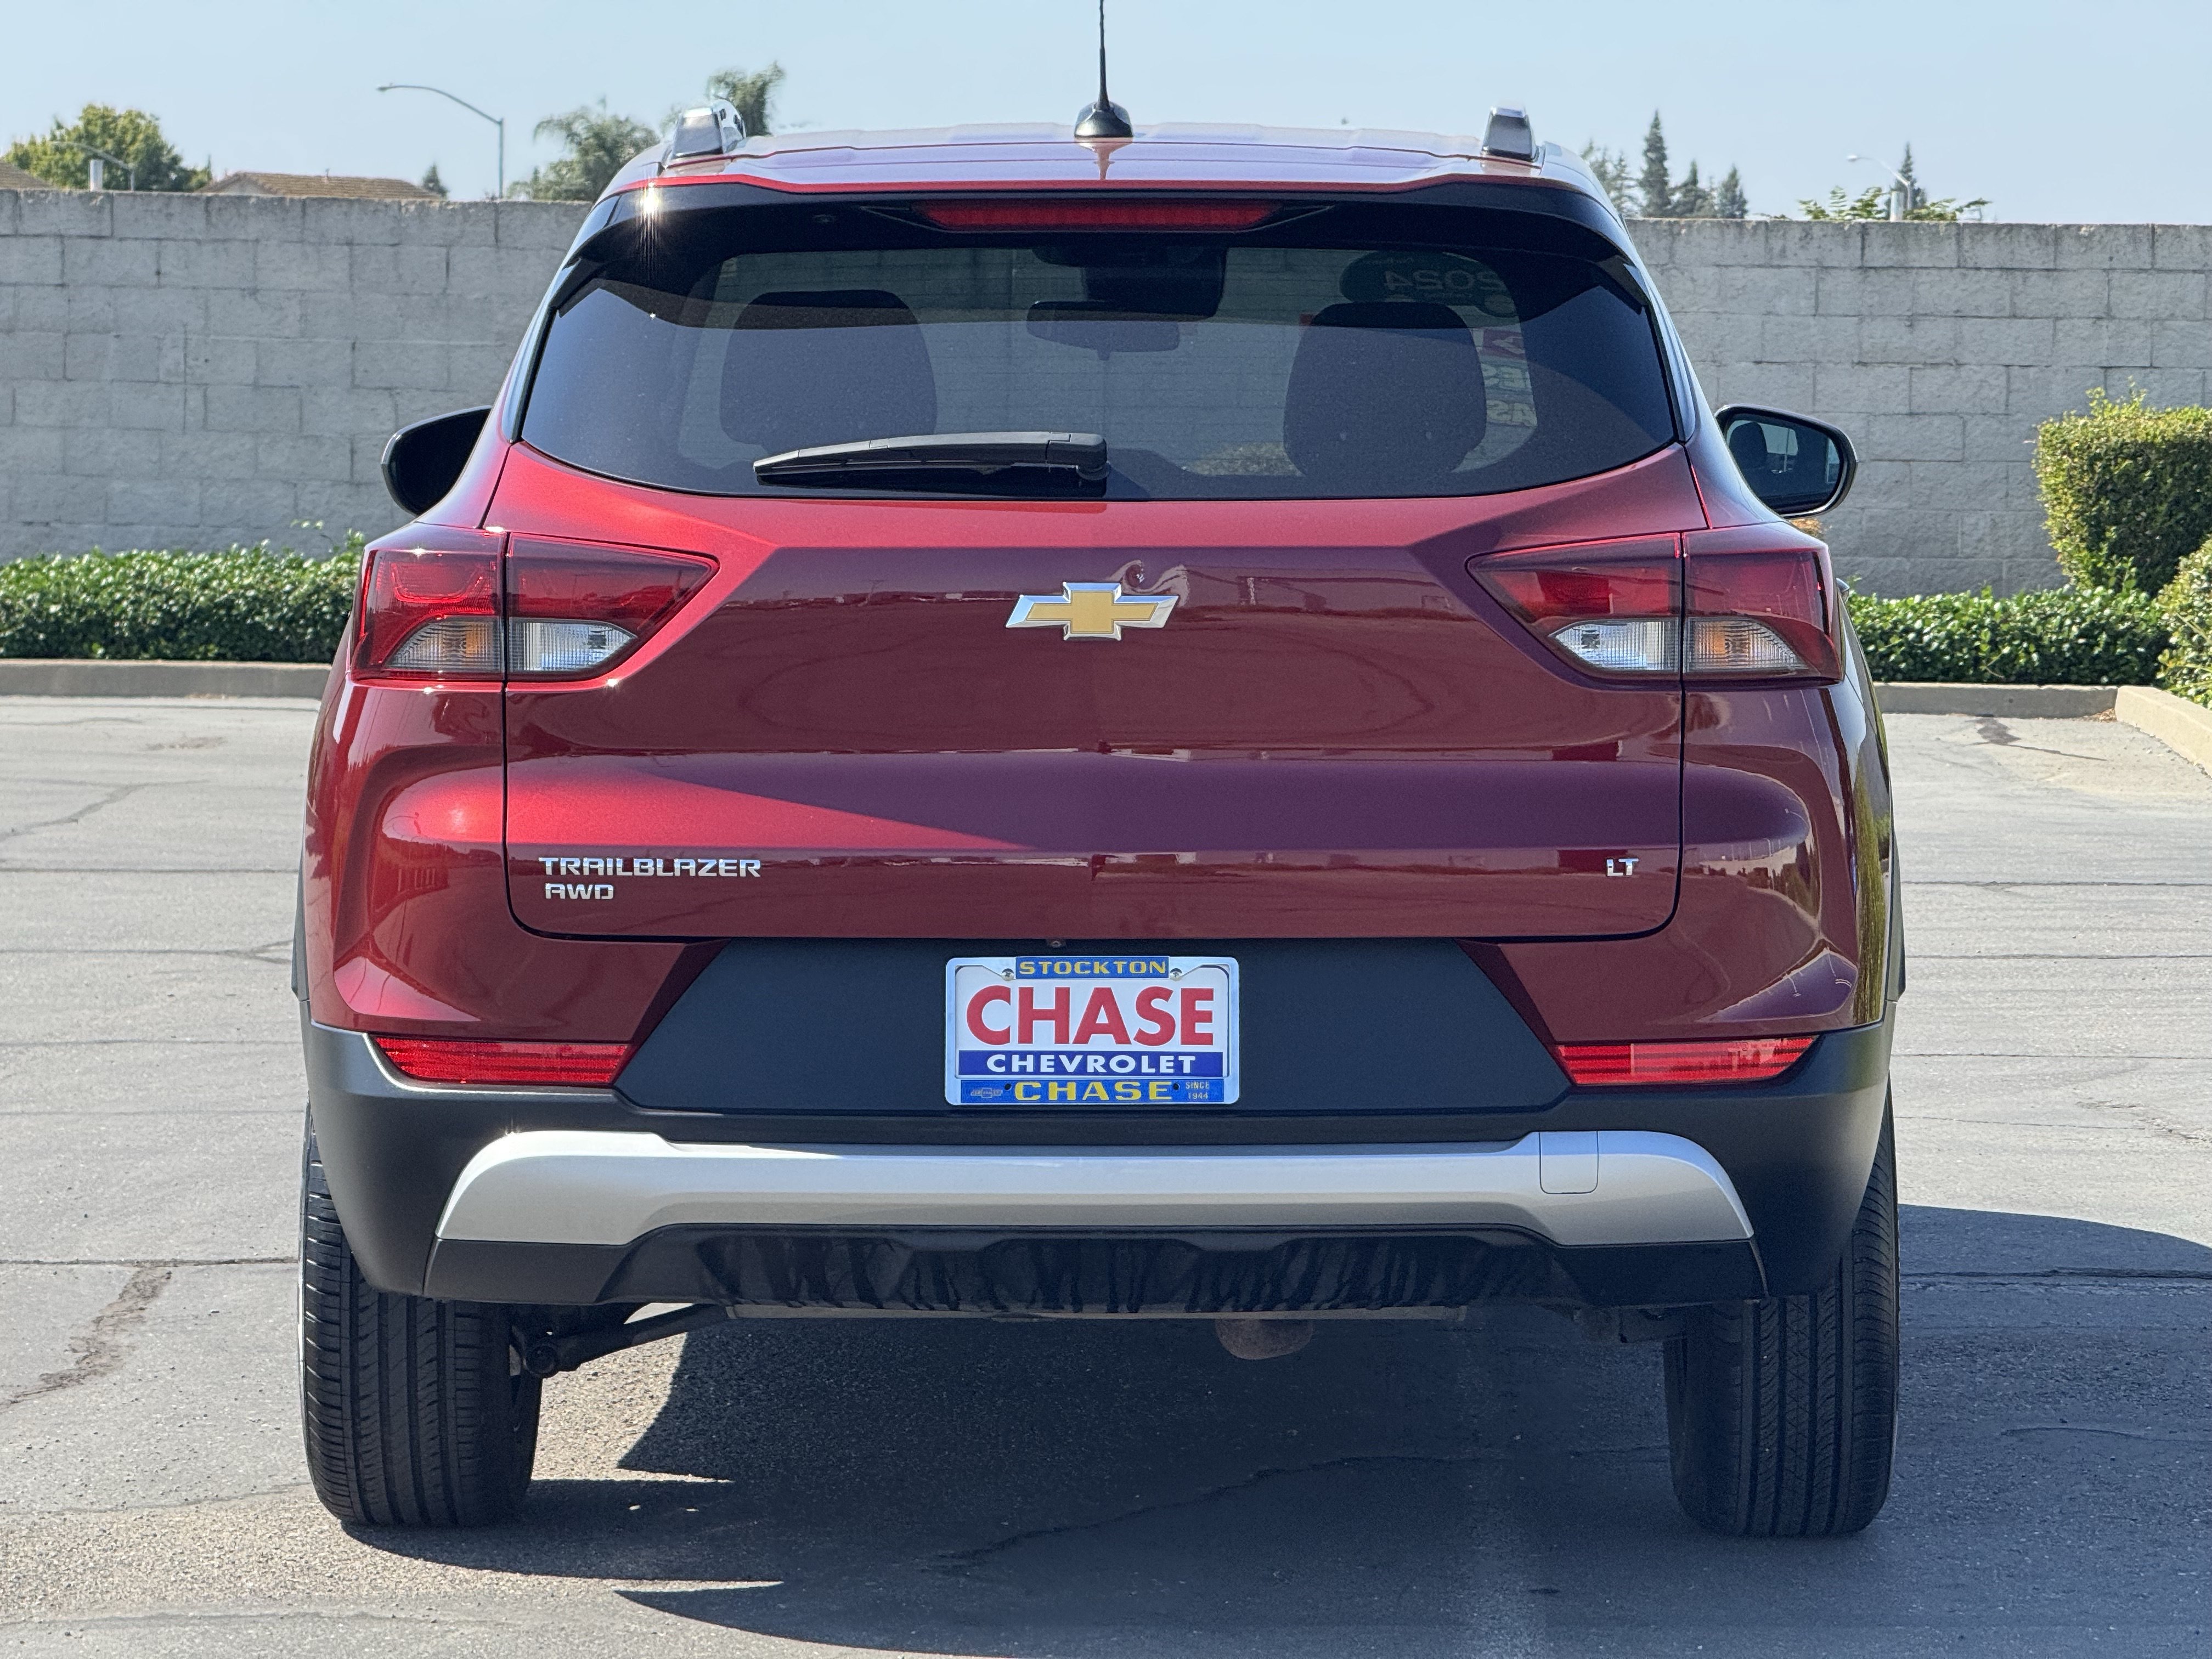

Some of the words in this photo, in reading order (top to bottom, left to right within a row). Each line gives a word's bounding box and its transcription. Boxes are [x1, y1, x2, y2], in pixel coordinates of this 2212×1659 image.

[539, 857, 761, 877] TRAILBLAZER
[1606, 858, 1639, 877] LT
[545, 883, 614, 900] AWD
[1019, 961, 1166, 975] STOCKTON
[966, 985, 1214, 1047] CHASE
[986, 1054, 1196, 1074] CHEVROLET
[1014, 1081, 1172, 1101] CHASE
